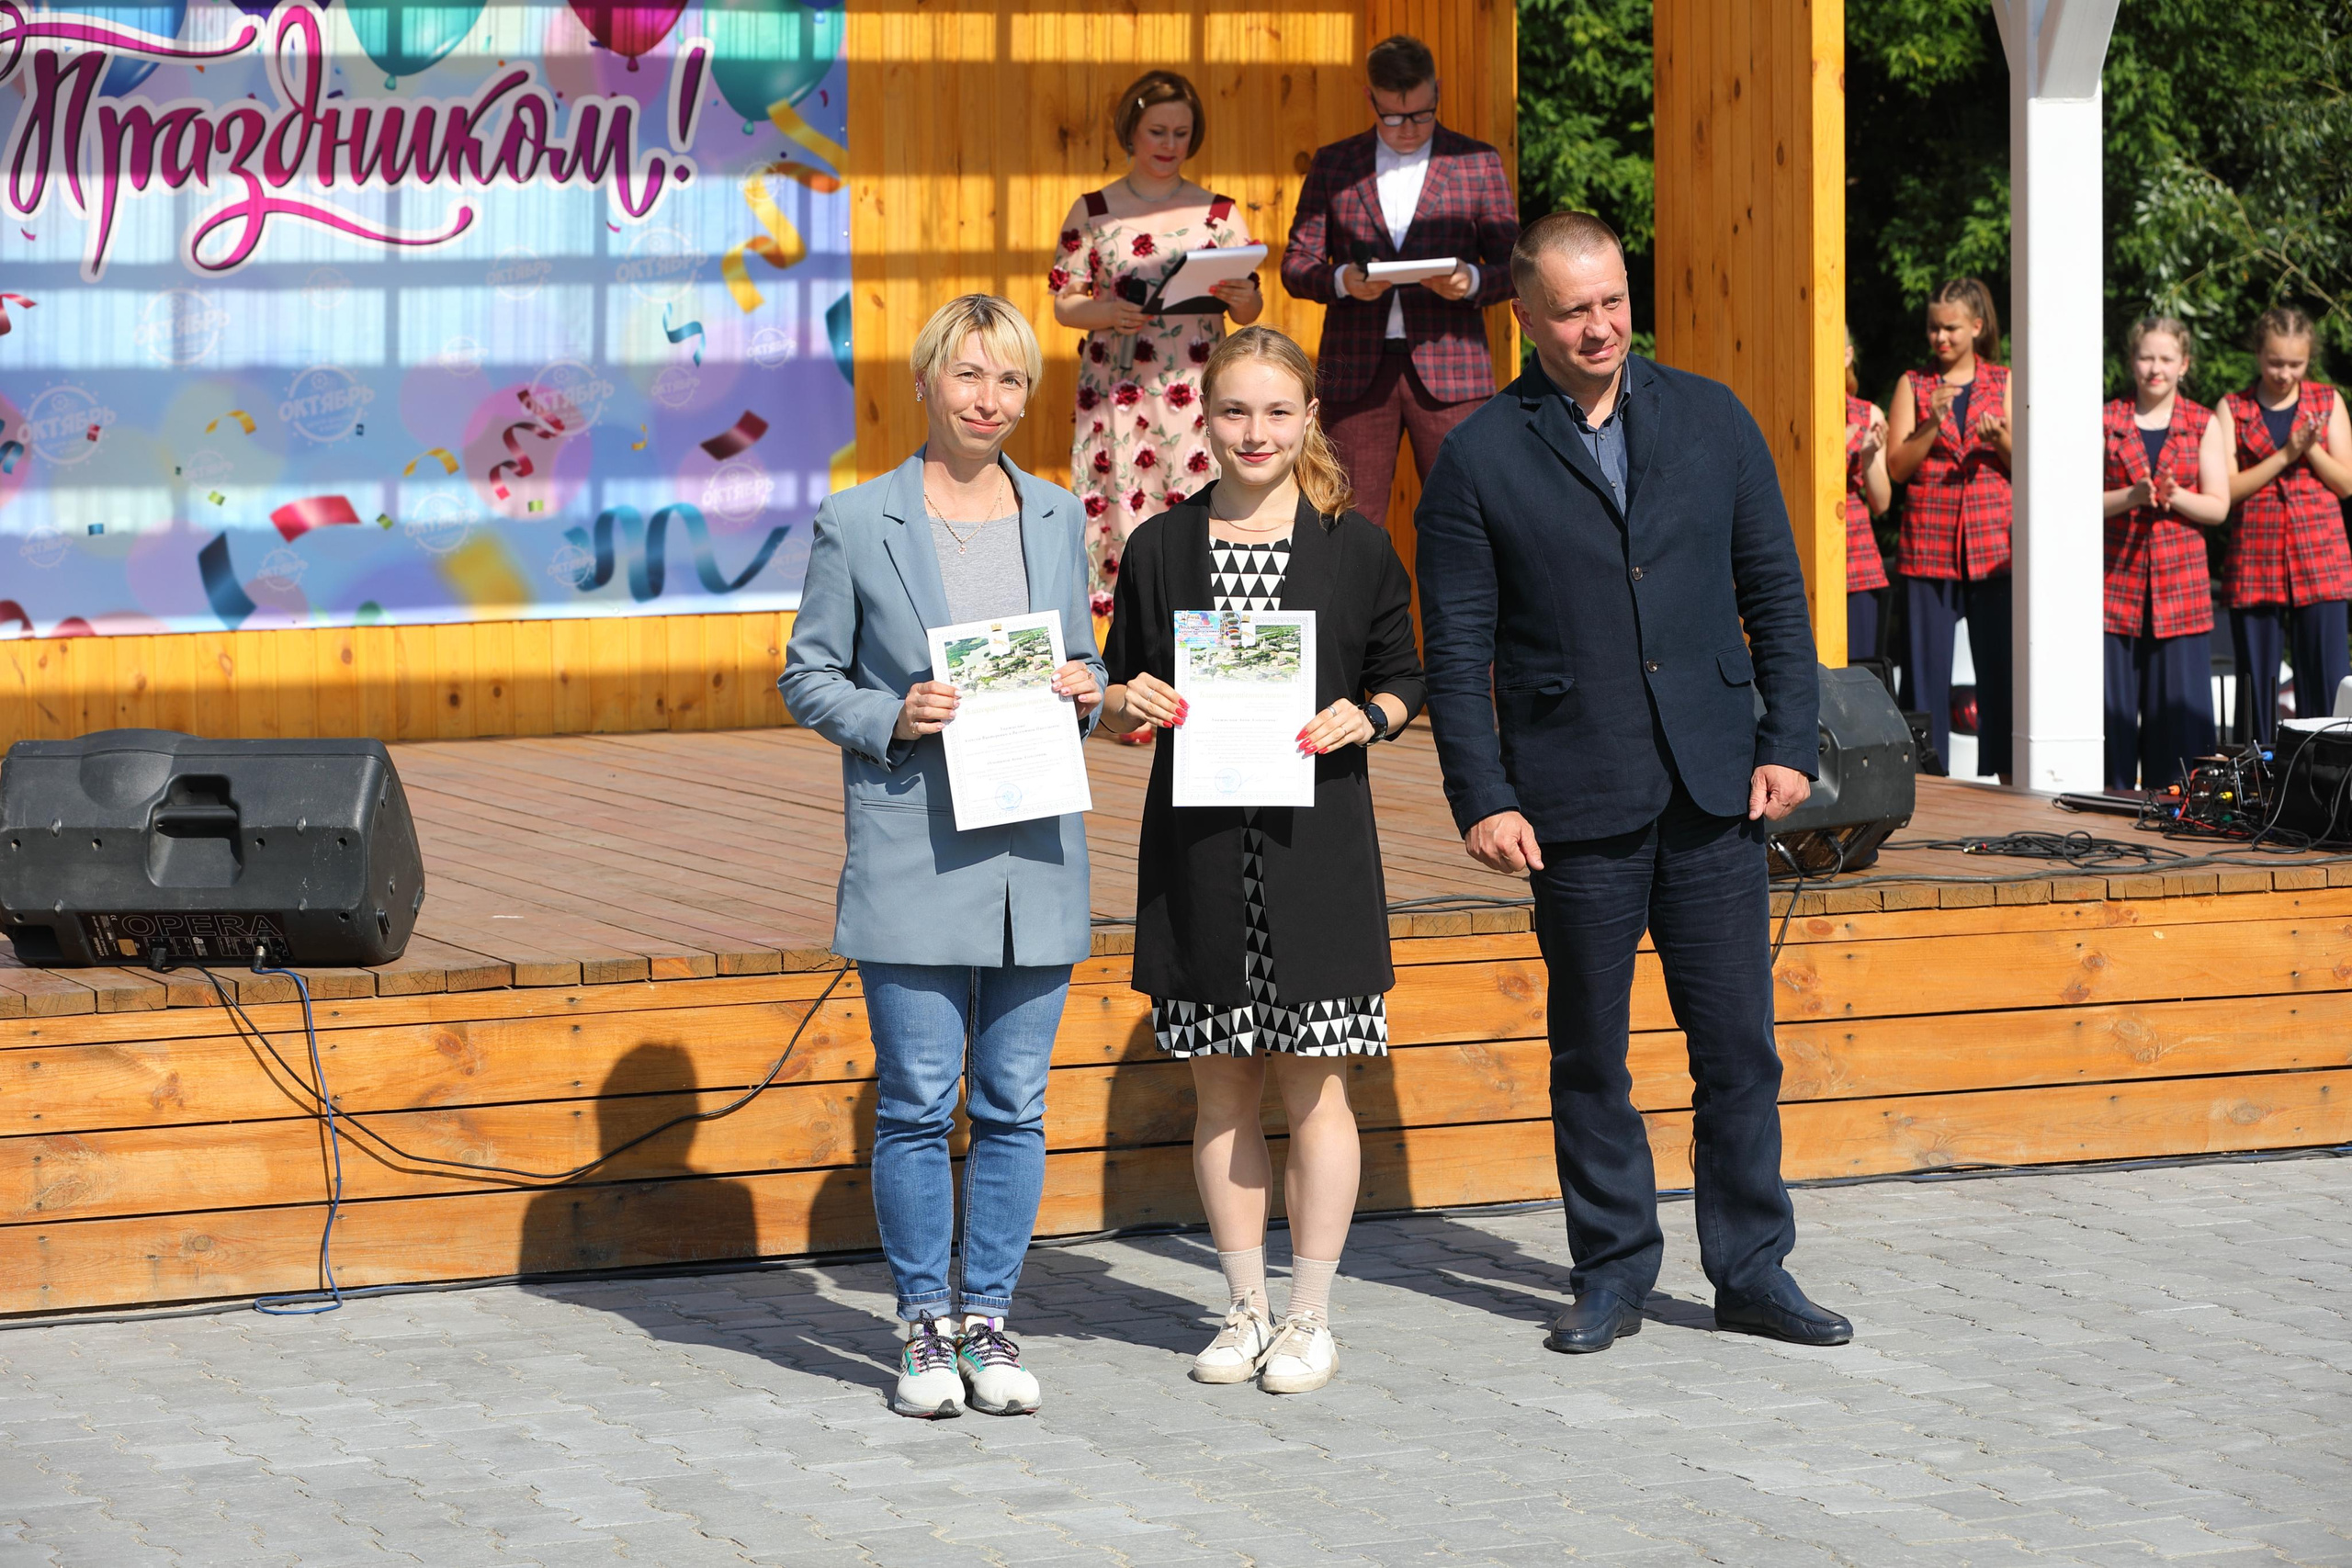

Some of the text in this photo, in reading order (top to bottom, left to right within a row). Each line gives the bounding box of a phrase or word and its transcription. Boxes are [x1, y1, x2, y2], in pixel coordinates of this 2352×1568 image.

[9, 5, 707, 275] Праздником!
[616, 249, 708, 283] ОКТЯБРЬ
[277, 384, 376, 422] ОКТЯБРЬ
[17, 406, 117, 446] ОКТЯБРЬ
[702, 476, 775, 507] ОКТЯБРЬ
[121, 915, 283, 936] OPERA
